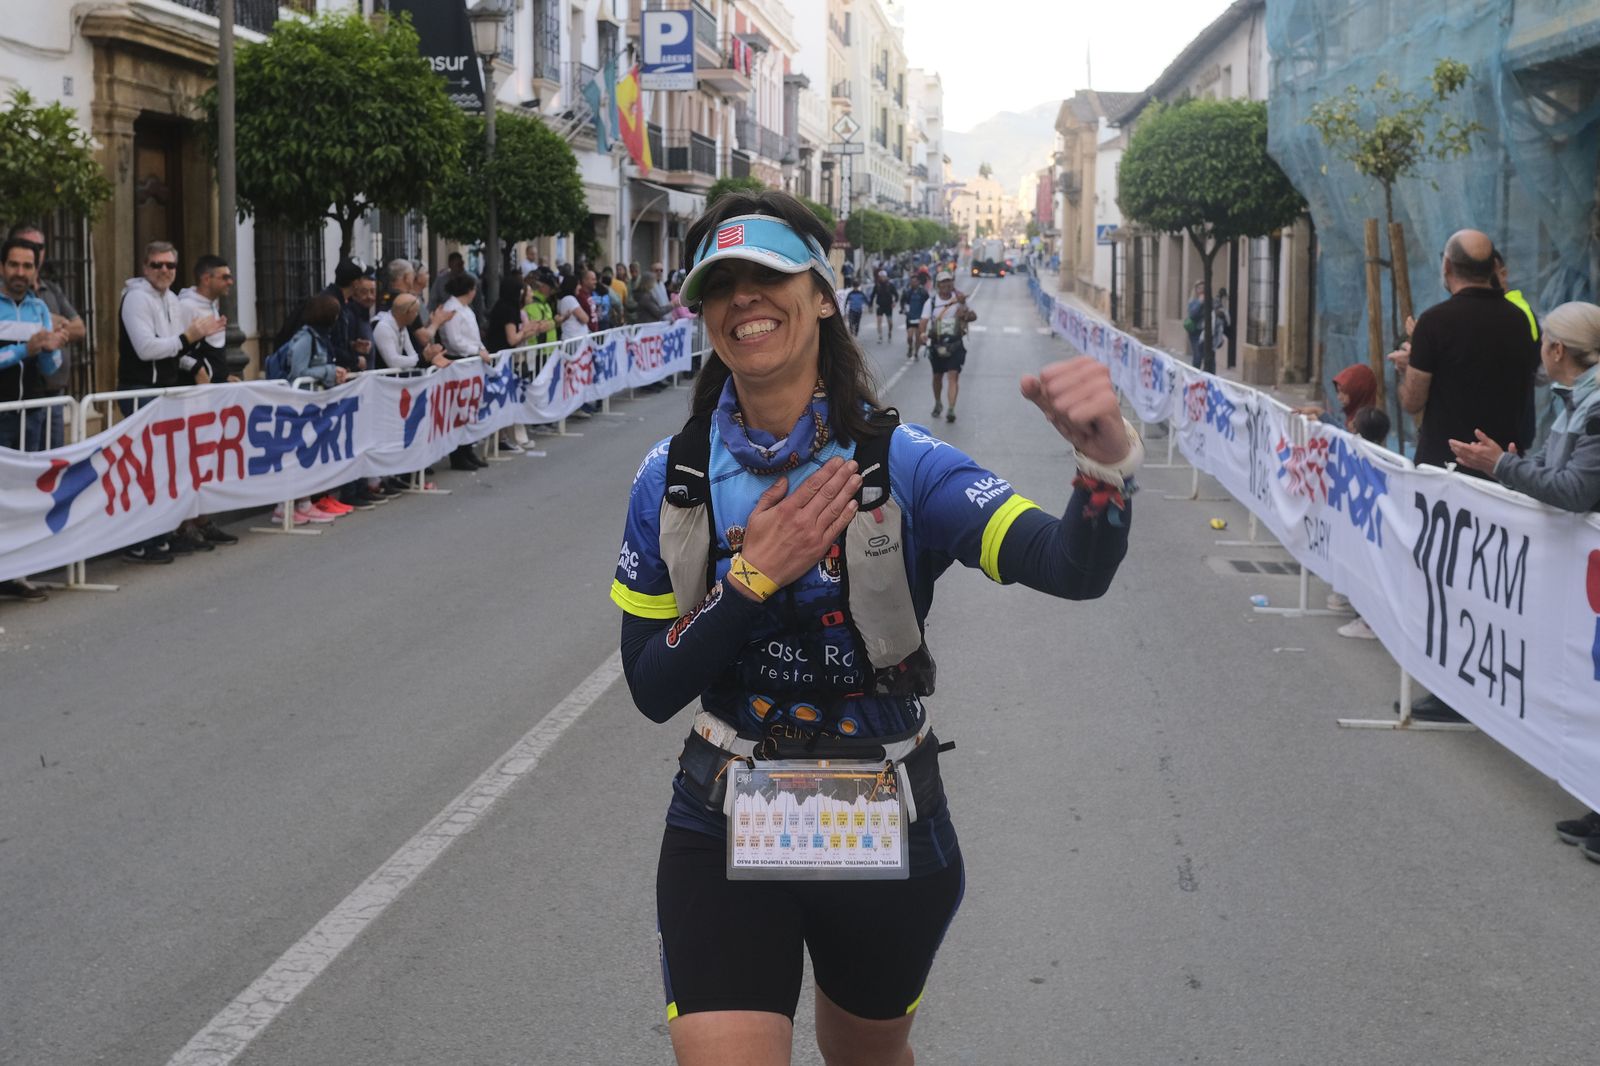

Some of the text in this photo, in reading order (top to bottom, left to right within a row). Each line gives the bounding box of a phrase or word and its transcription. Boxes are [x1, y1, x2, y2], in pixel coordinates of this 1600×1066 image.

[101, 396, 360, 517] INTERSPORT
[864, 541, 900, 558] Kalenji
[1457, 608, 1526, 719] 24H
